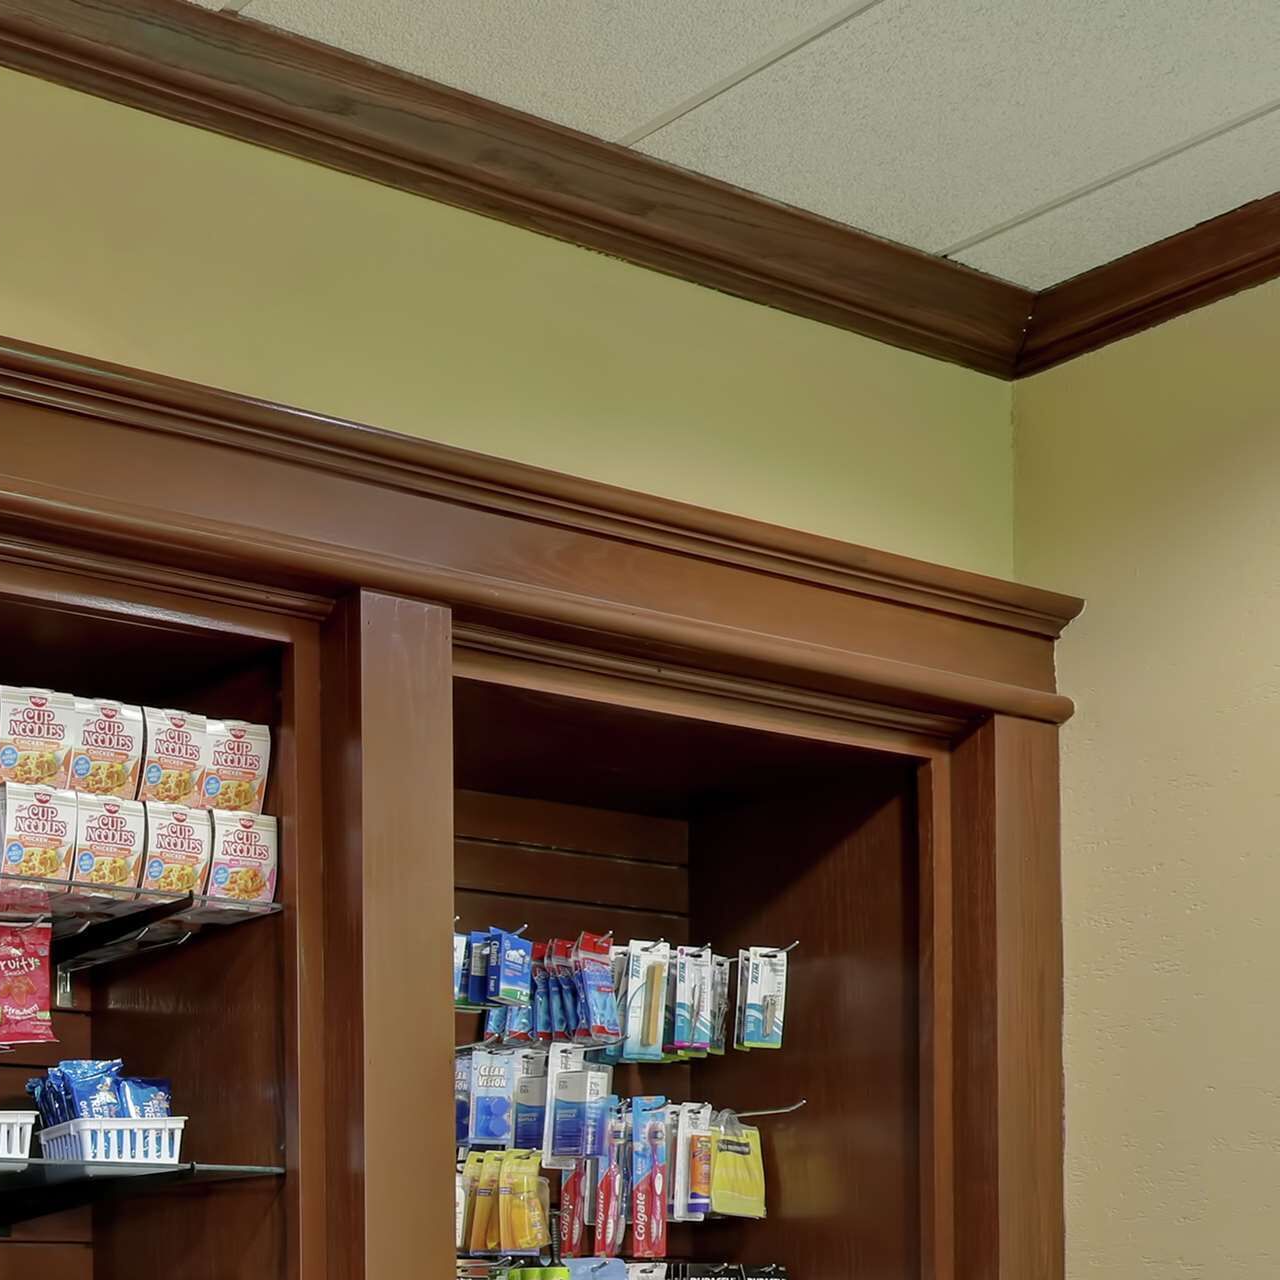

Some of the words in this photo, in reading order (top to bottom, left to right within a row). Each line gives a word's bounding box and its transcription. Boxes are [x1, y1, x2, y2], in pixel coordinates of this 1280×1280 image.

[22, 708, 55, 723] CUP
[9, 721, 64, 740] NOODLES
[95, 720, 124, 734] CUP
[82, 732, 133, 750] NOODLES
[165, 729, 191, 744] CUP
[154, 740, 200, 760] NOODLES
[224, 741, 252, 755] CUP
[213, 752, 260, 770] NOODLES
[27, 804, 58, 819] CUP
[15, 818, 66, 836] NOODLES
[98, 815, 127, 830] CUP
[86, 828, 135, 846] NOODLES
[168, 824, 193, 838] CUP
[233, 830, 260, 844] CUP
[156, 835, 203, 854] NOODLES
[221, 841, 270, 860] NOODLES
[480, 1065, 505, 1076] CLEAR
[478, 1076, 506, 1088] VISION
[634, 1192, 646, 1240] Colgate
